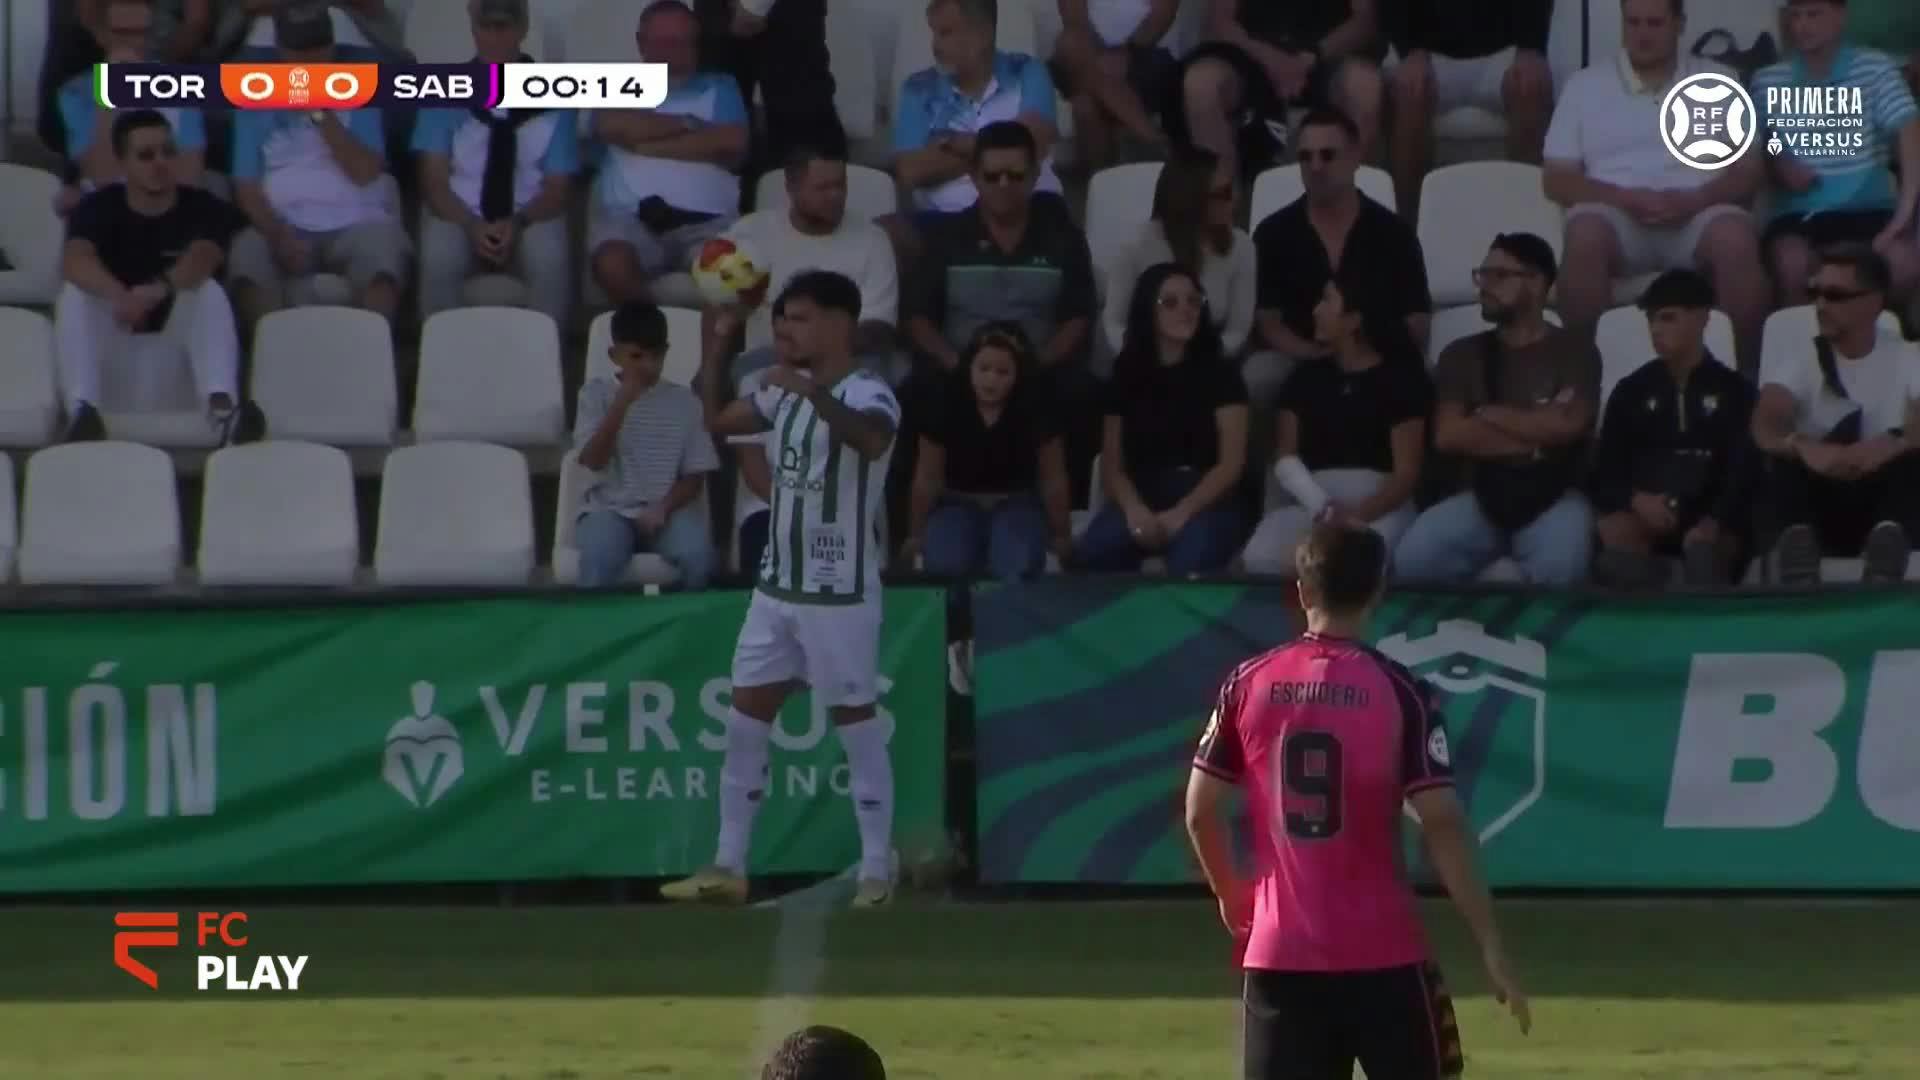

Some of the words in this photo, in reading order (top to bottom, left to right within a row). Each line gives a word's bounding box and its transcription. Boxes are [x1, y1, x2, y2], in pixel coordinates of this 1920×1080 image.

[0, 660, 217, 820] IÓN
[1269, 681, 1370, 707] ESCUDERO
[1283, 730, 1345, 839] 9
